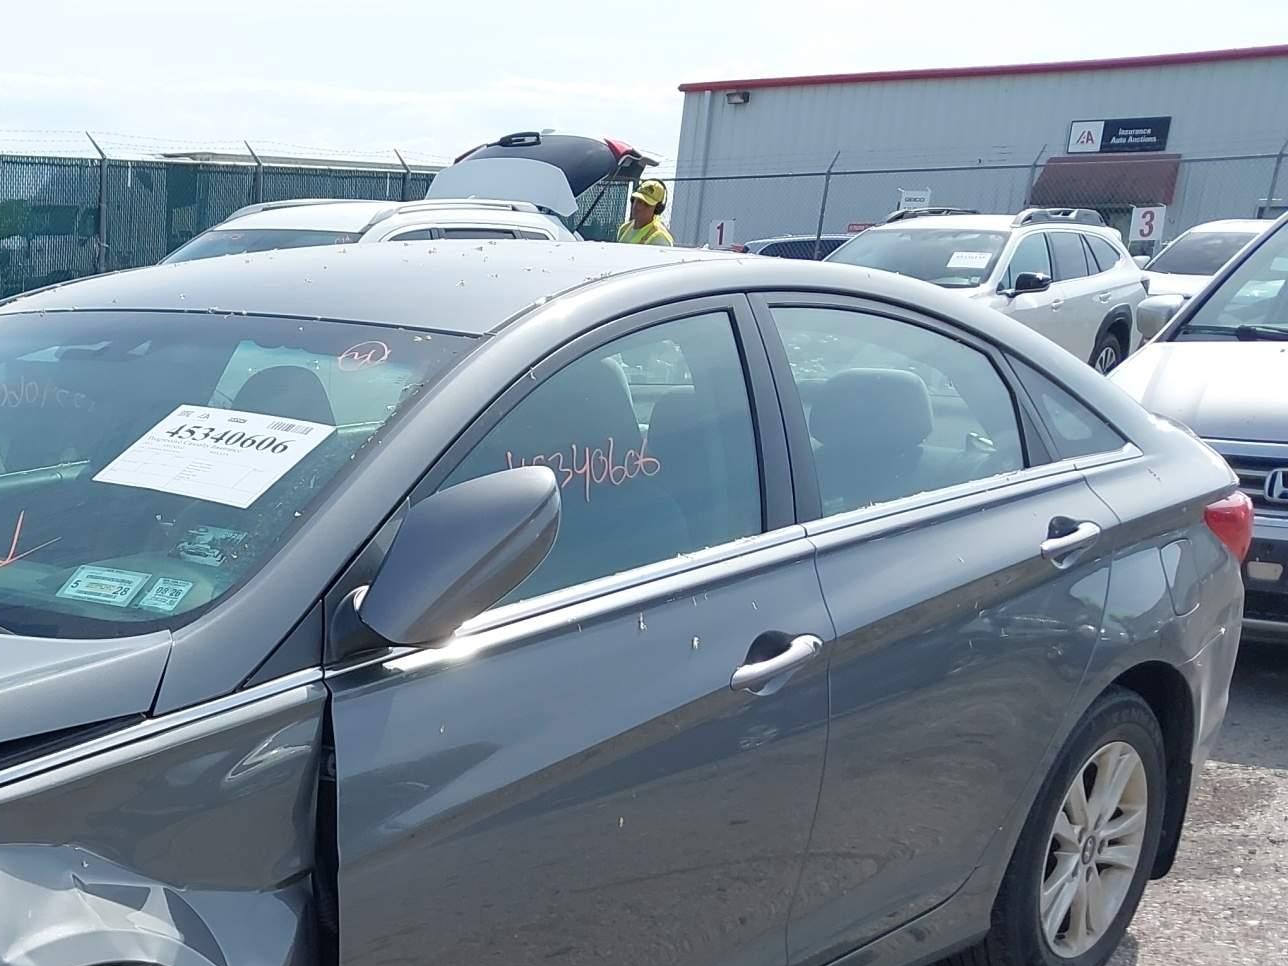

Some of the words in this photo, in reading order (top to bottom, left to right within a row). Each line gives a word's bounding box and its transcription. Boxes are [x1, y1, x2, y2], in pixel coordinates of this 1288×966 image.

[1110, 136, 1126, 144] Auto
[1127, 134, 1157, 143] Auctions
[1118, 127, 1152, 135] Insurance
[716, 222, 724, 245] 1
[1140, 210, 1155, 238] 3
[165, 424, 295, 454] 45340606
[71, 579, 81, 589] 5
[112, 586, 131, 596] 28
